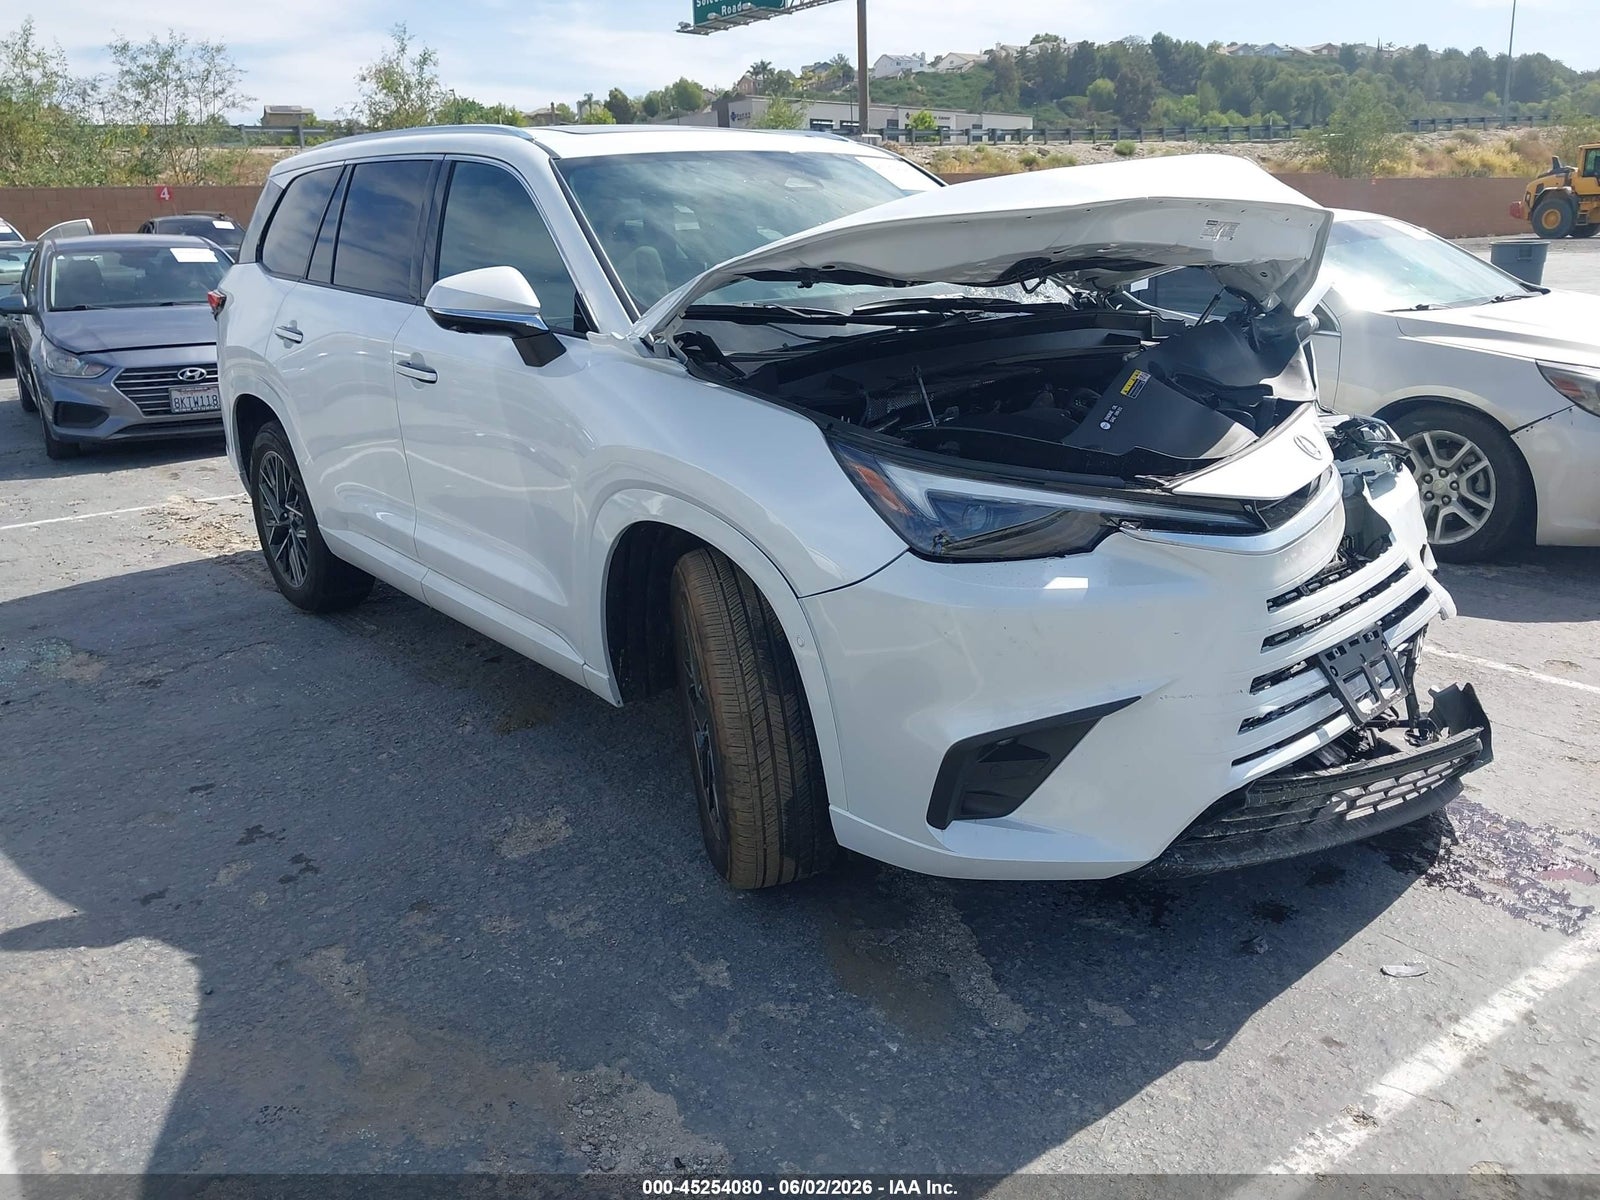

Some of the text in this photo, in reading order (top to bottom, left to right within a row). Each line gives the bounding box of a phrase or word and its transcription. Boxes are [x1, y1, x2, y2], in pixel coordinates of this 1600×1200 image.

[721, 1, 742, 16] Road
[160, 187, 170, 200] 4
[173, 394, 219, 409] 8KTW118
